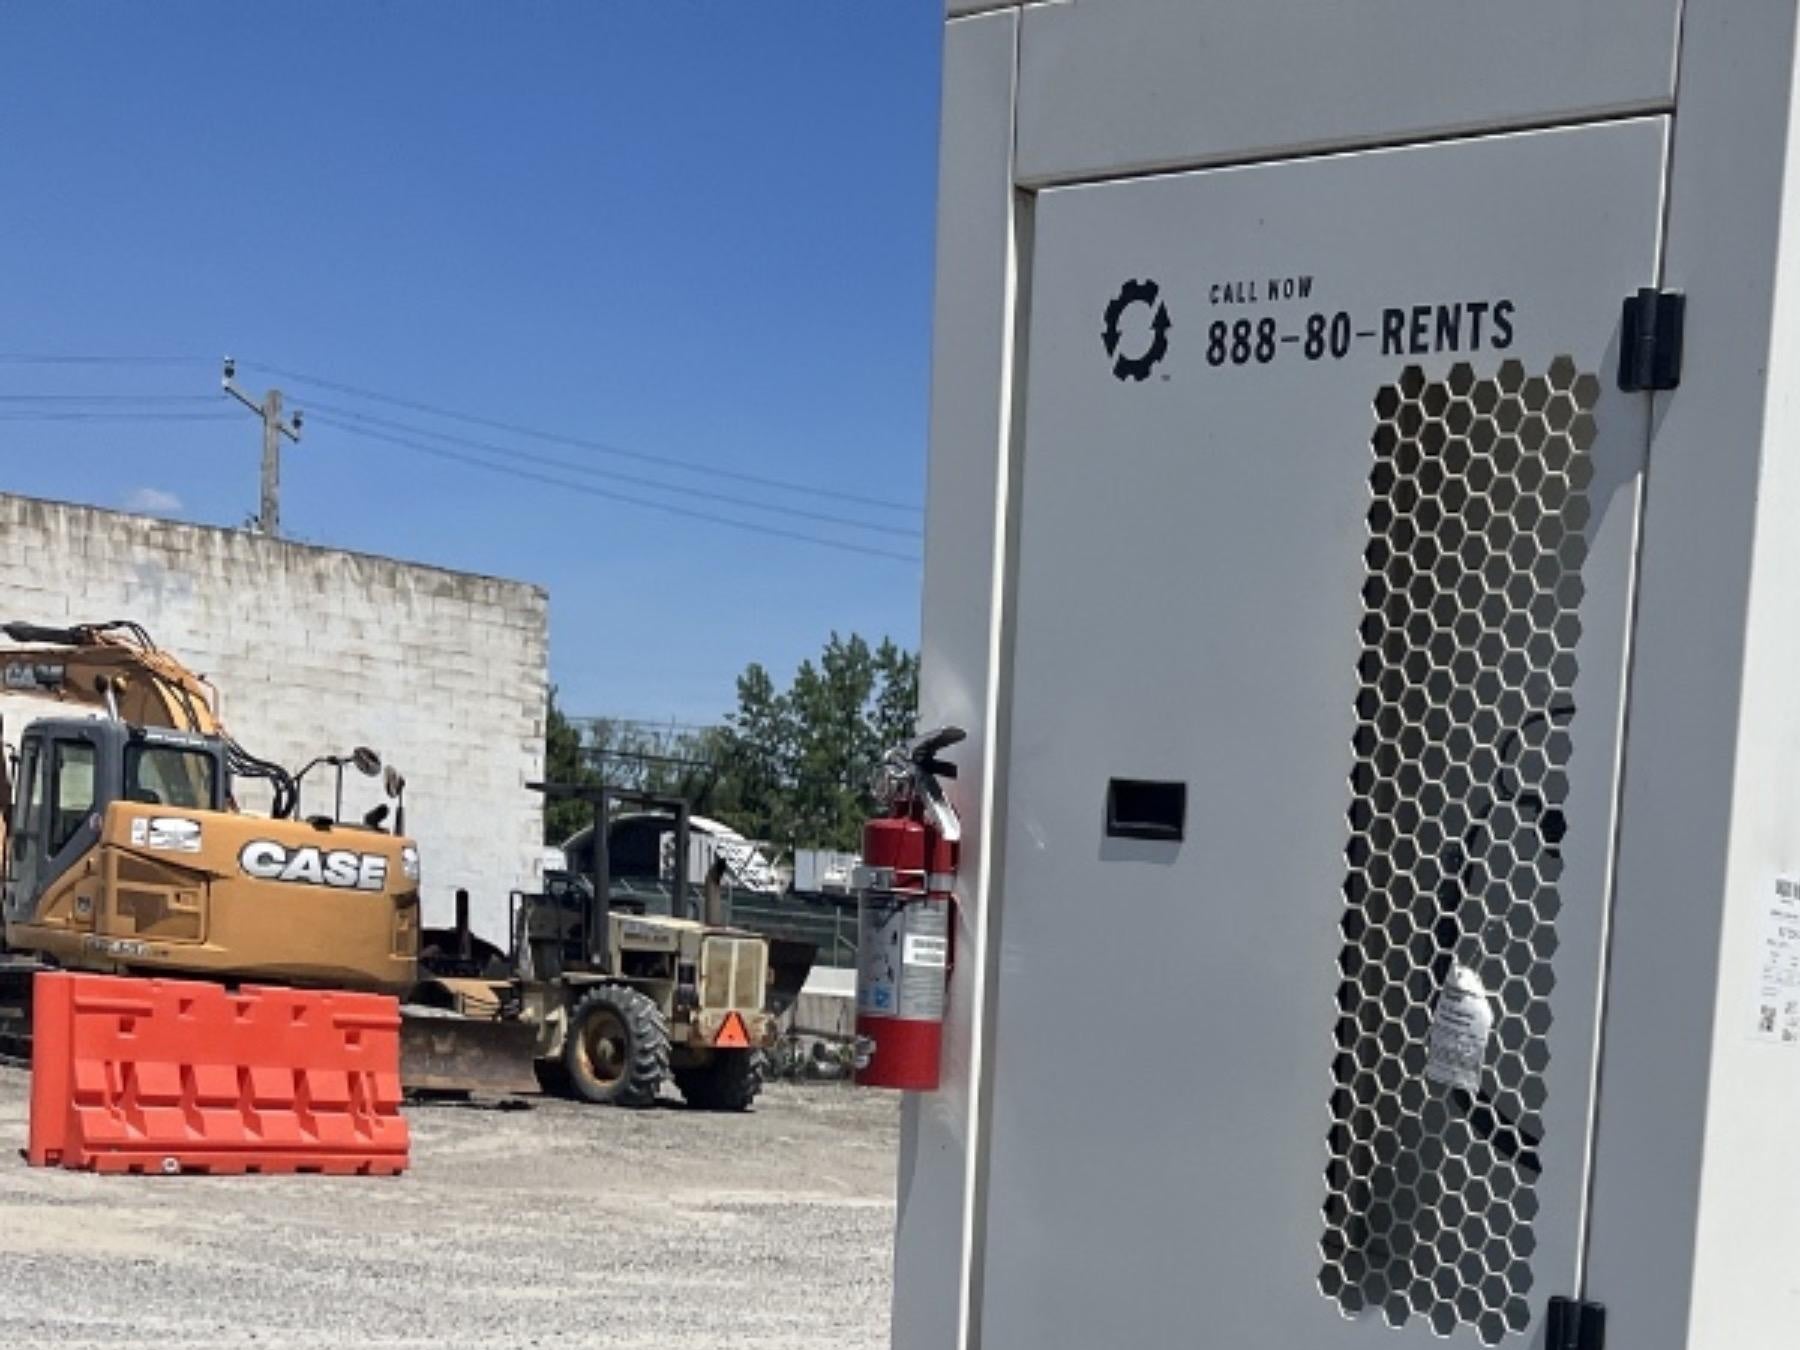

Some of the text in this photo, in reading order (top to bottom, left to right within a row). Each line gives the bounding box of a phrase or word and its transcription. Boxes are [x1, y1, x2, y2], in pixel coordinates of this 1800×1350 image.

[1209, 276, 1314, 304] CALL NOW
[1205, 299, 1515, 367] 888-80-RENTS
[240, 840, 389, 890] CASE
